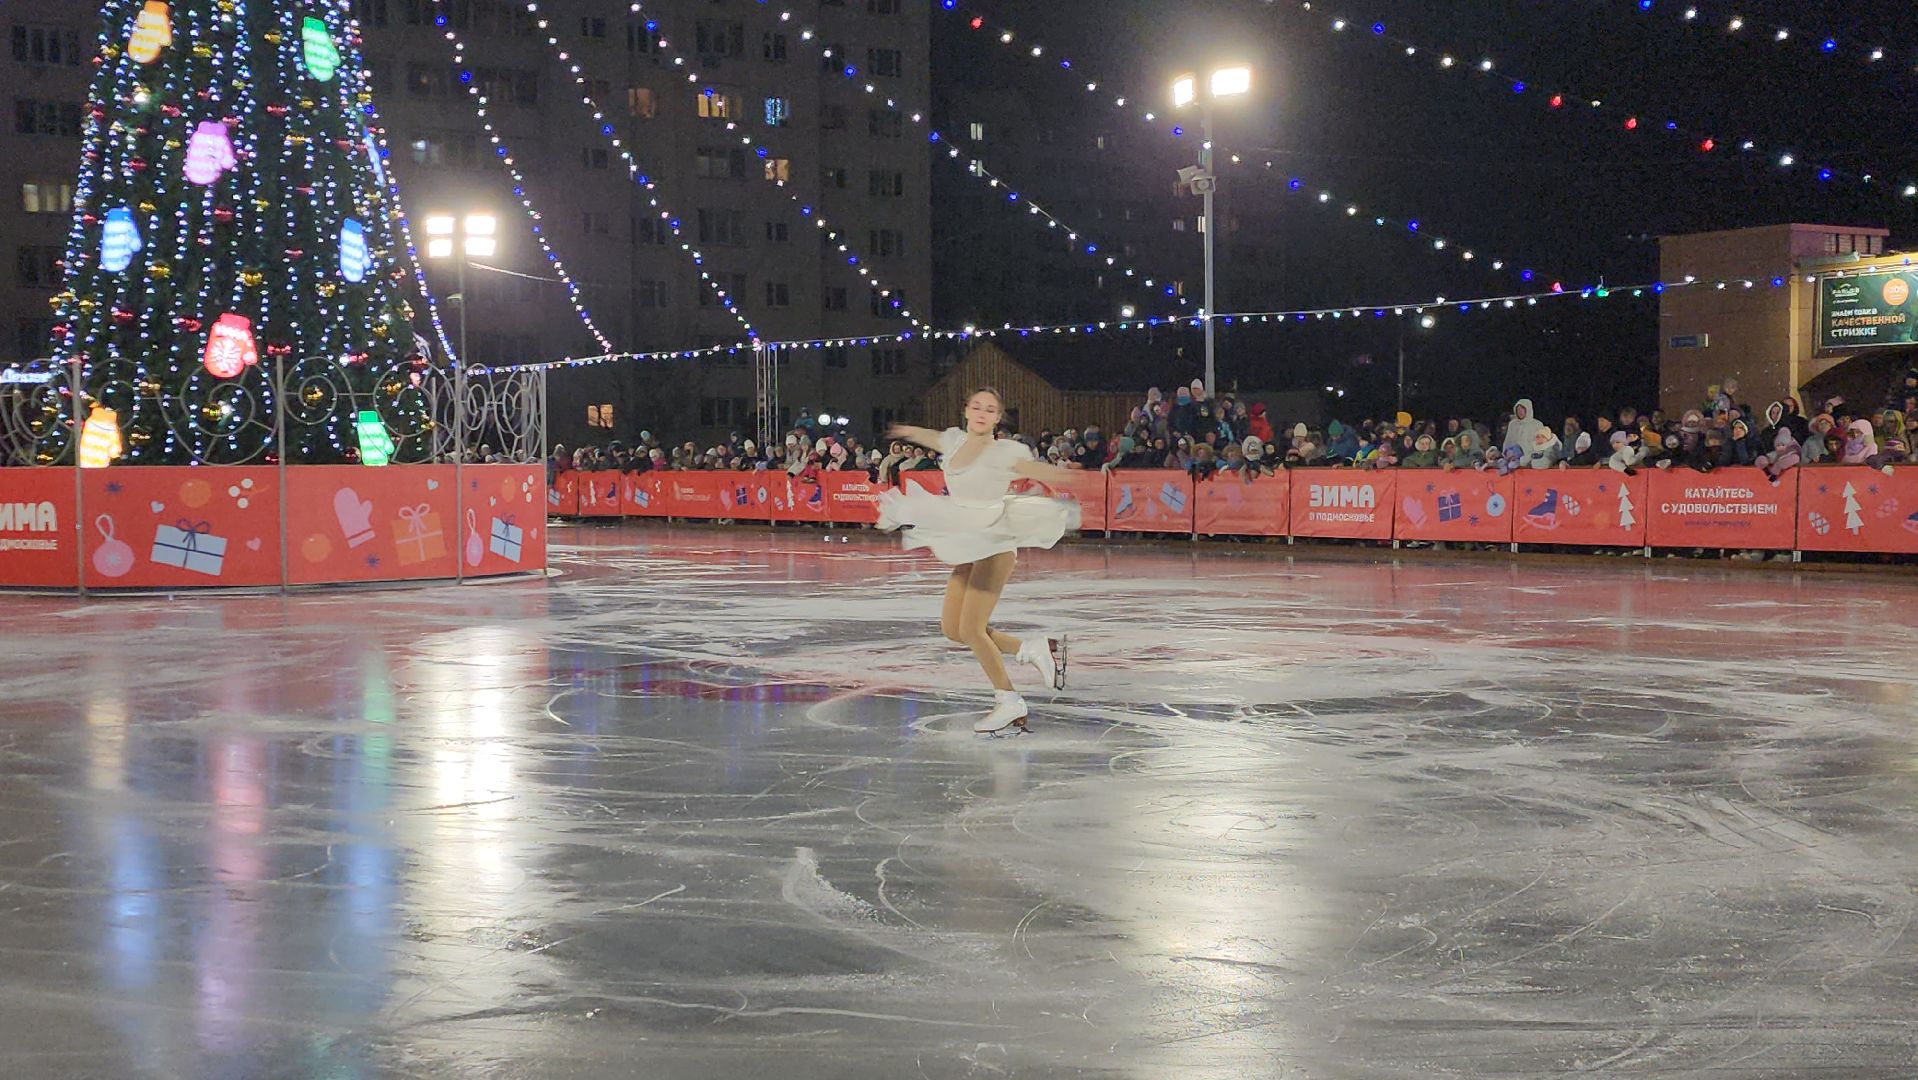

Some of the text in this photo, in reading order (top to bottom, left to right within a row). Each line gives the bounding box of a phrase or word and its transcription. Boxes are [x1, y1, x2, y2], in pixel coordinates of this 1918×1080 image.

[1831, 313, 1906, 328] КАЧЕСТВЕННОЙ
[1831, 327, 1878, 338] СТРИЖКЕ
[1309, 484, 1375, 508] ЗИМА
[1684, 486, 1754, 499] КАТАЙТЕСЬ
[1661, 503, 1778, 515] С УДОВОЛЬСТВИЕМ!
[1316, 512, 1375, 523] ПОДМОСКОВЬЕ
